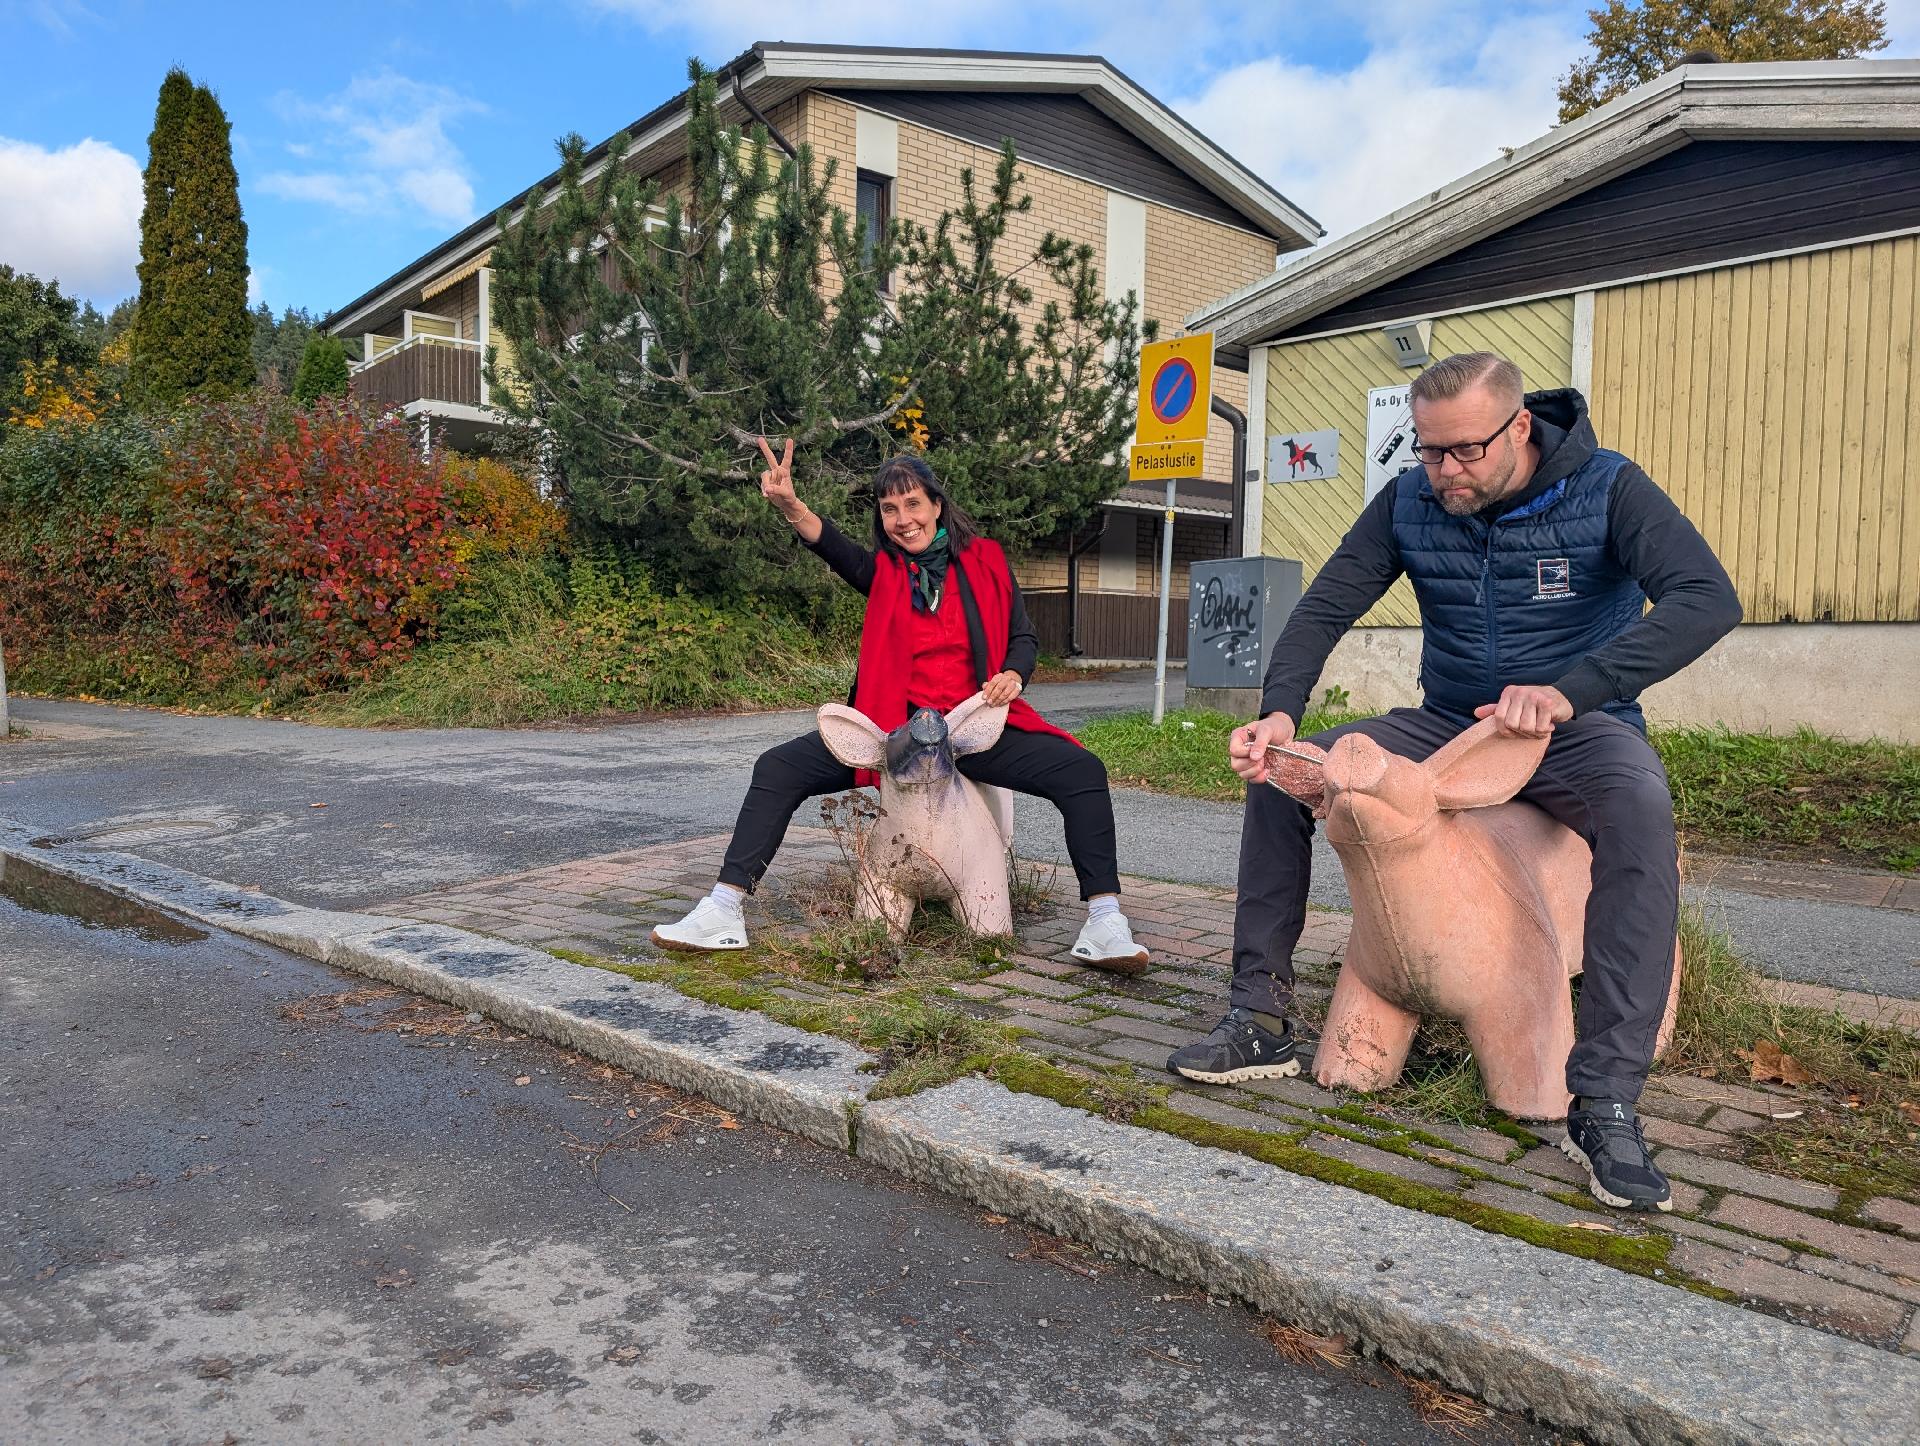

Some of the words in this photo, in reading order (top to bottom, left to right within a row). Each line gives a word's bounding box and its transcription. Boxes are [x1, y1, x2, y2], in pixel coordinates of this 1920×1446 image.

[1395, 336, 1411, 351] 11
[1375, 397, 1386, 407] As
[1390, 395, 1401, 407] Oy
[1136, 452, 1196, 470] Pelastustie
